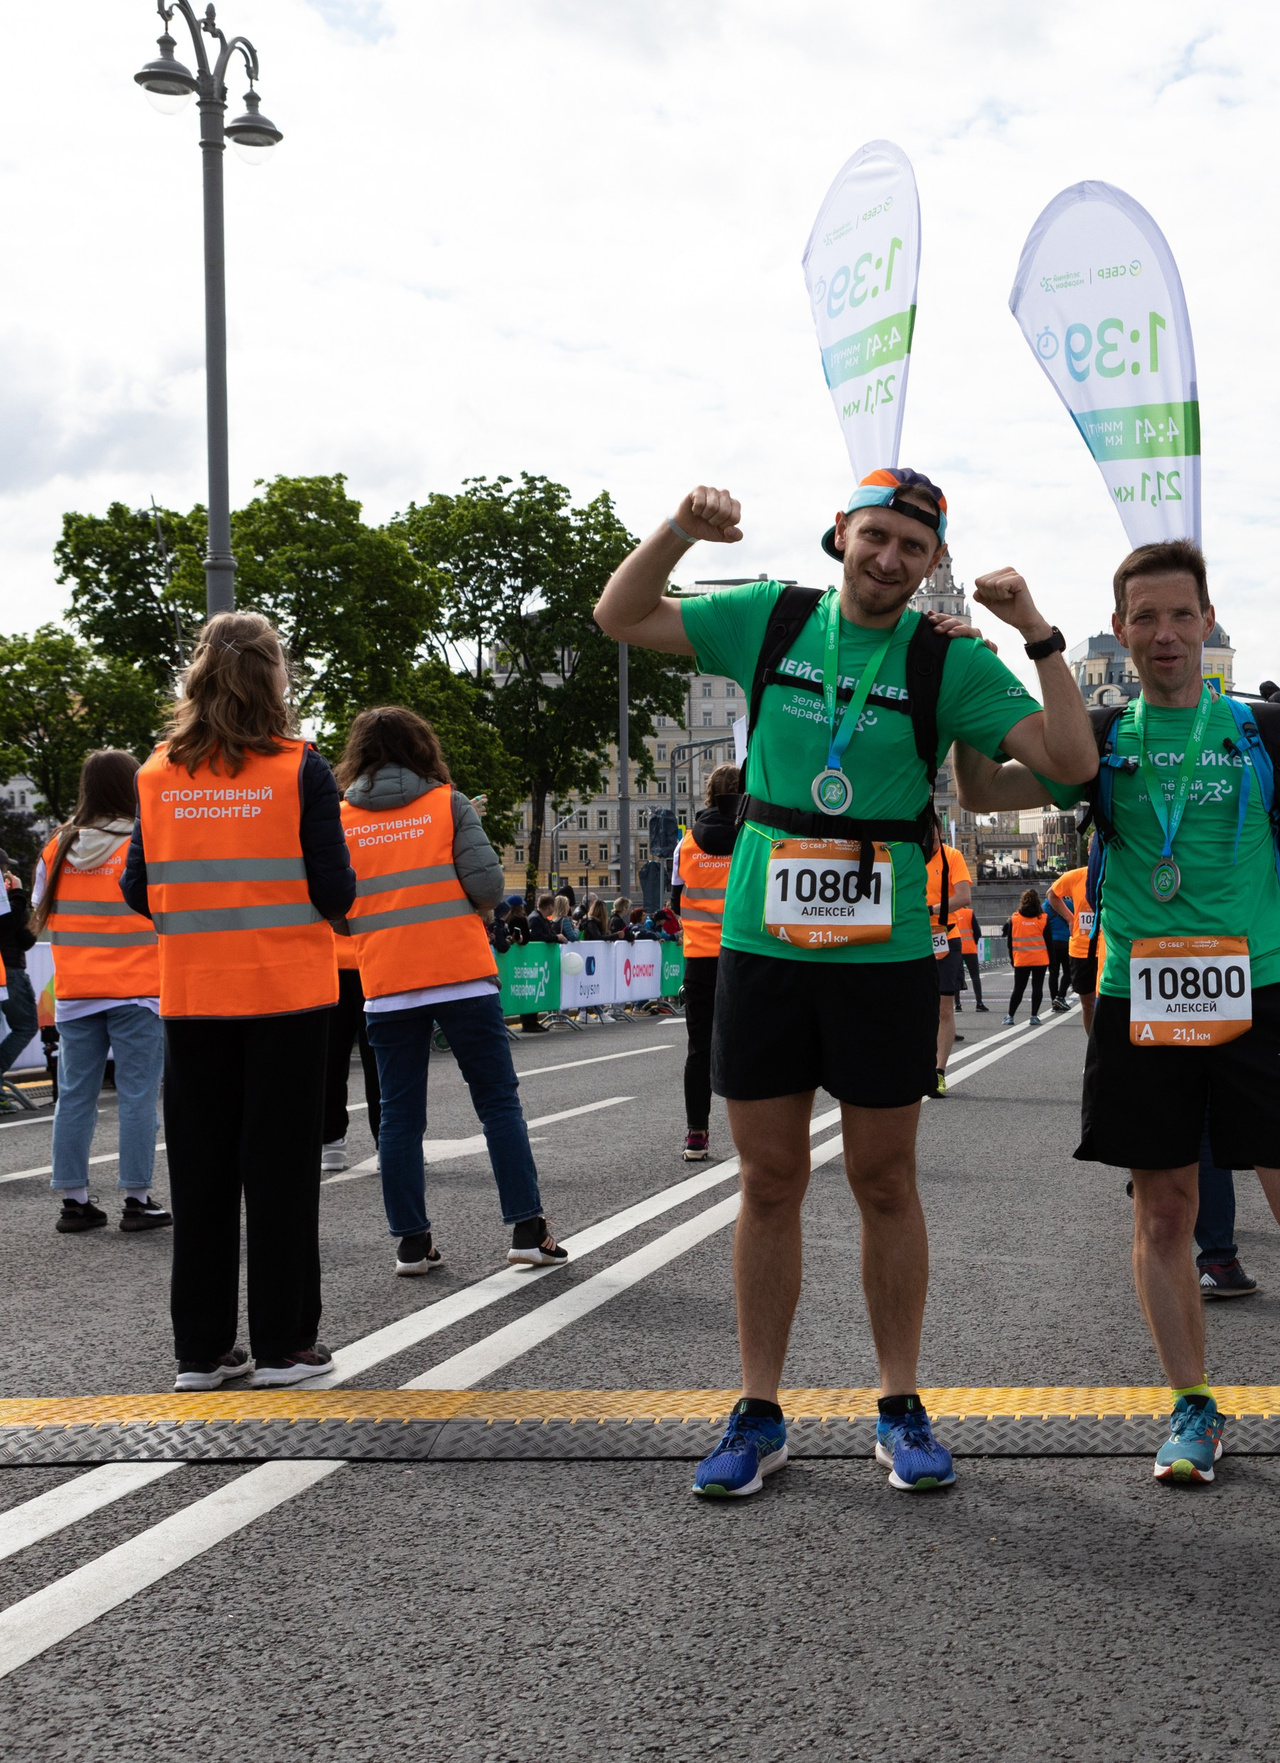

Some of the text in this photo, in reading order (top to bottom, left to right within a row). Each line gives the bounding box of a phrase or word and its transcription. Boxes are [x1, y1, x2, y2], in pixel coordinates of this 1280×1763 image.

[161, 786, 273, 803] СПОРТИВНЫЙ
[174, 804, 262, 819] ВОЛОНТЁР
[344, 814, 432, 837] СПОРТИВНЫЙ
[358, 829, 425, 847] ВОЛОНТЁР
[775, 868, 882, 905] 10801
[801, 905, 855, 917] АЛЕКСЕЙ
[1138, 965, 1246, 1000] 10800
[1165, 1000, 1218, 1013] АЛЕКСЕЙ
